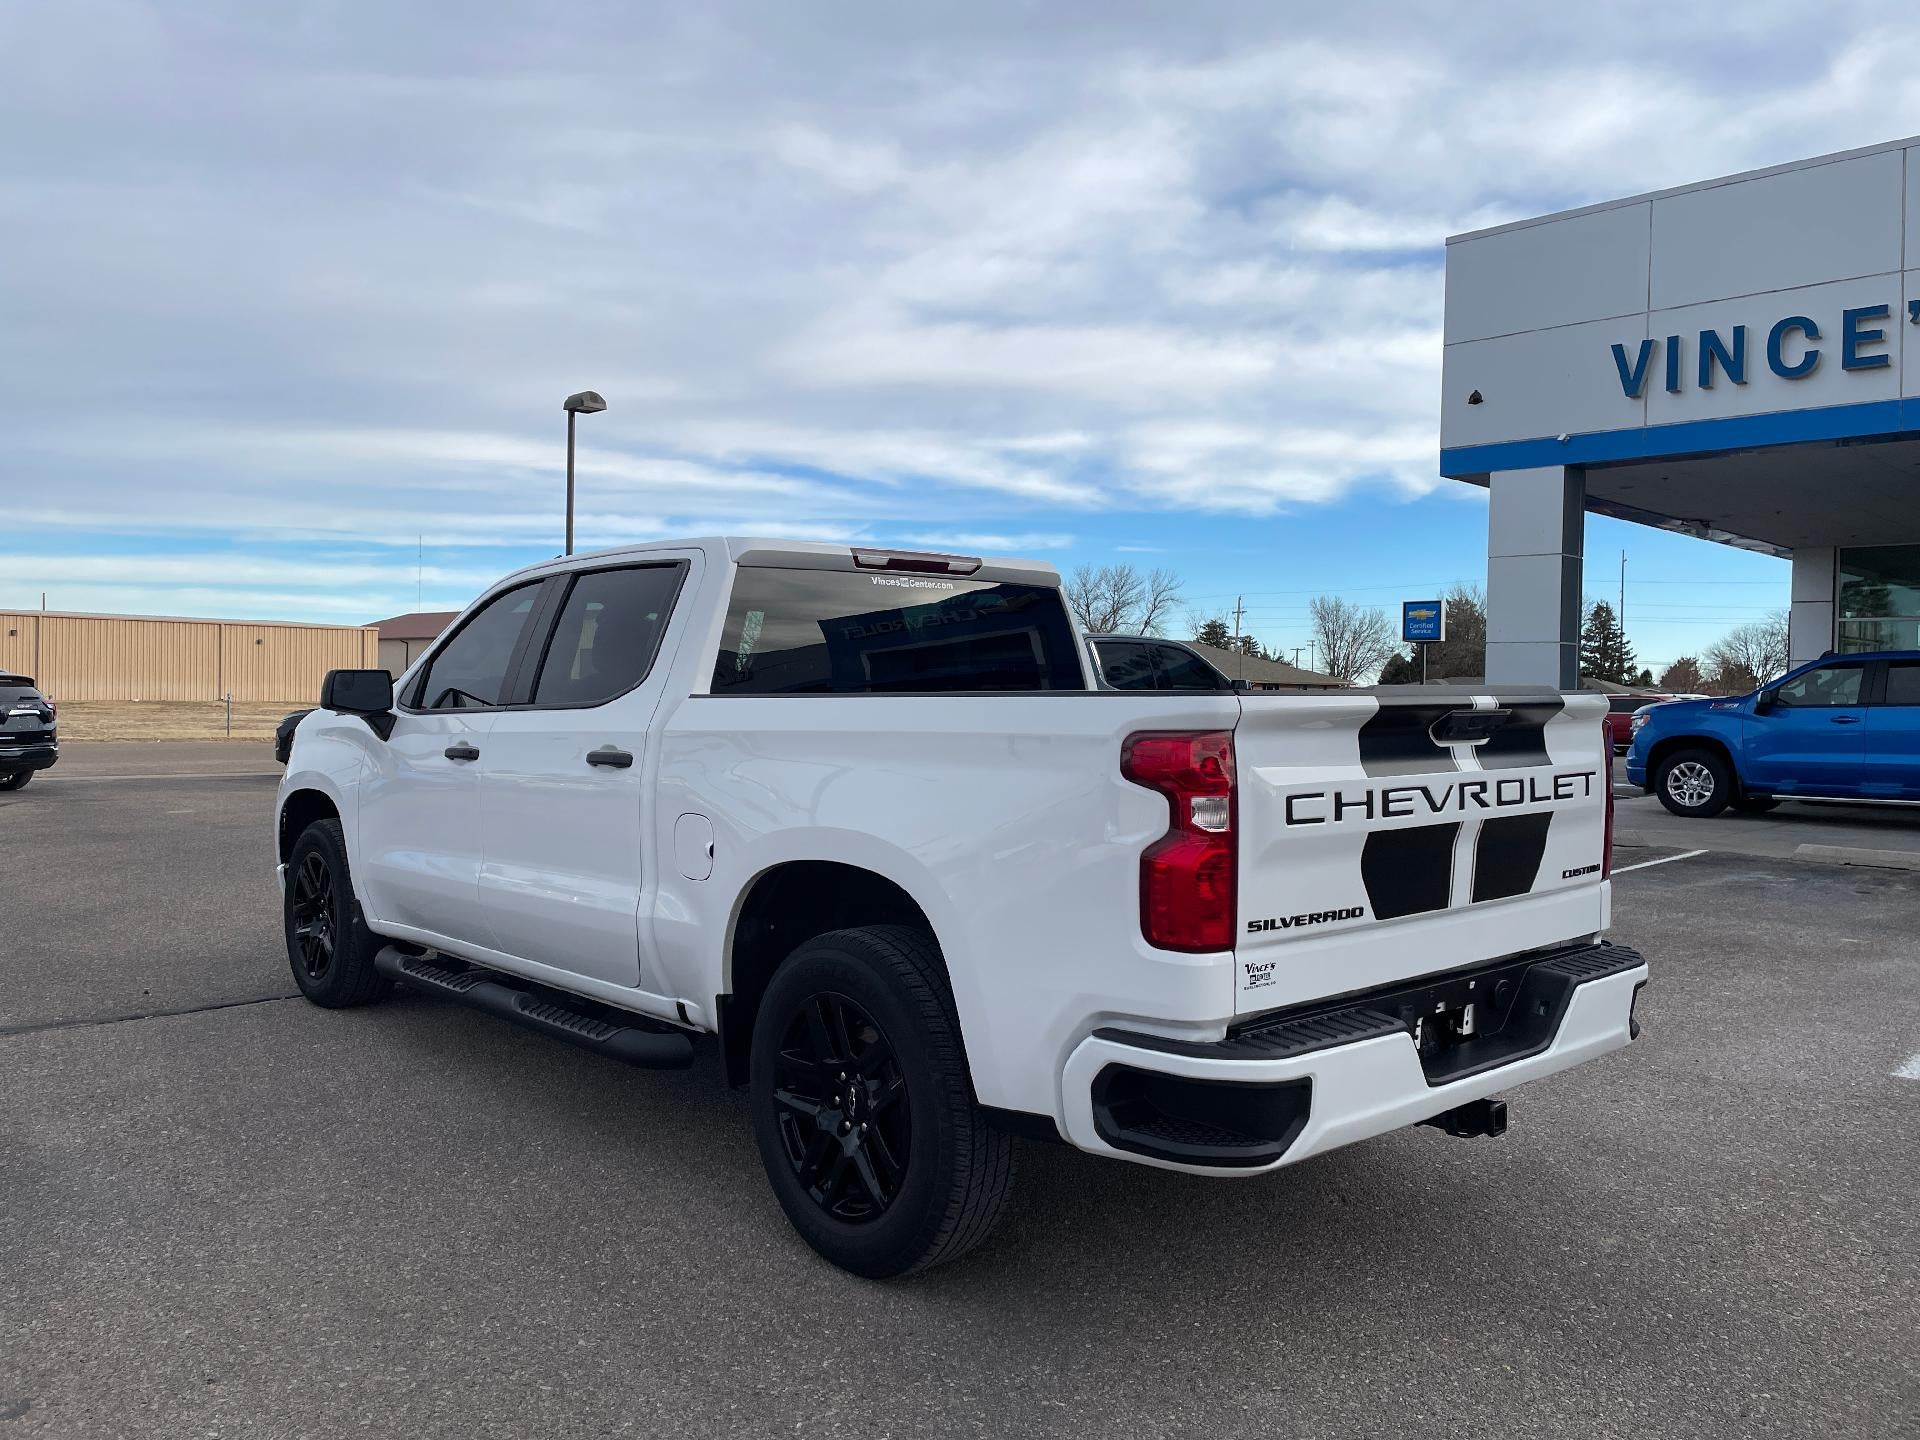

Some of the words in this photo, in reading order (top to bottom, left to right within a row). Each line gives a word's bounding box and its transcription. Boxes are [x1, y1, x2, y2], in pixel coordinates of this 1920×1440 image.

[1611, 299, 1920, 398] VINCE'
[1286, 771, 1596, 826] CHEVROLET
[1562, 864, 1600, 879] CUSTOM
[1247, 906, 1364, 933] SILVERADO
